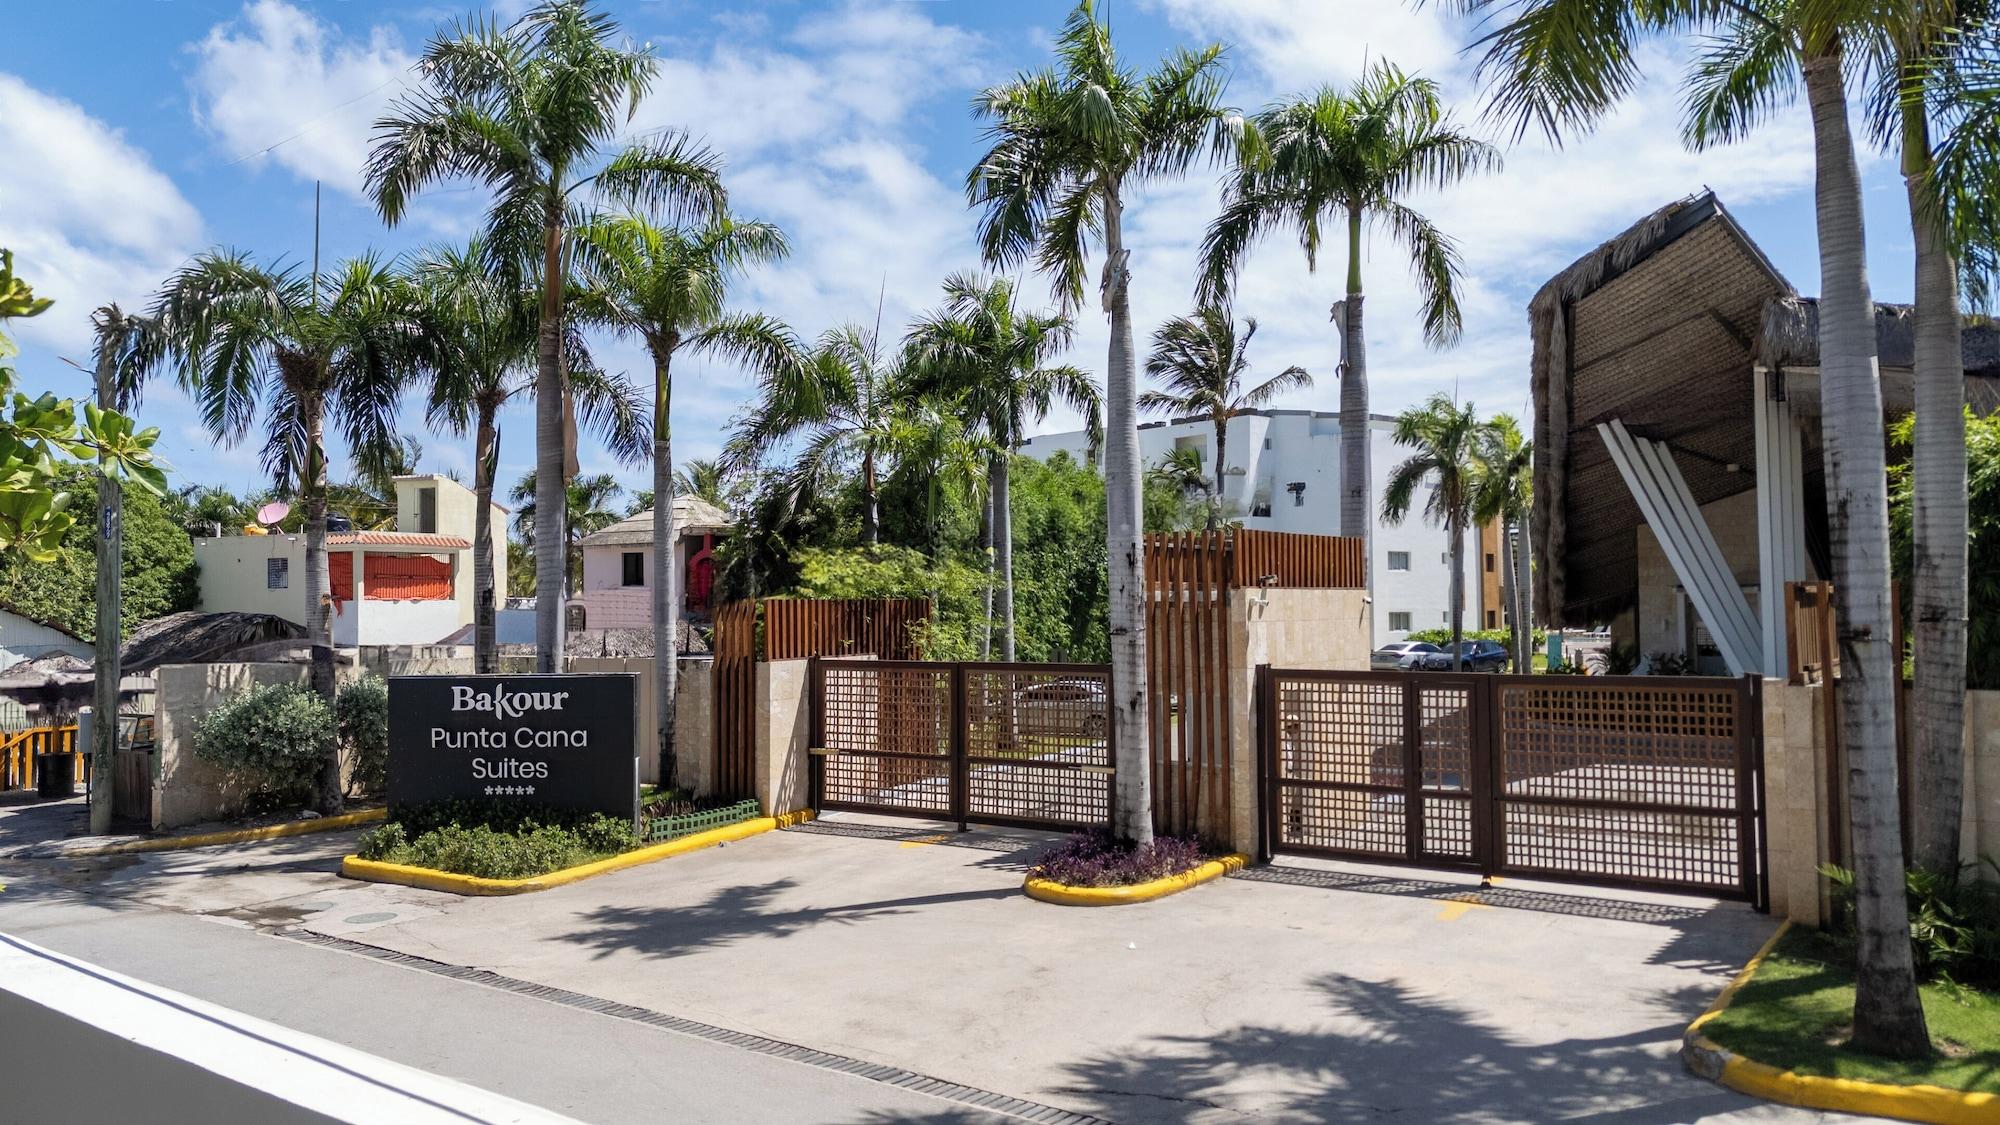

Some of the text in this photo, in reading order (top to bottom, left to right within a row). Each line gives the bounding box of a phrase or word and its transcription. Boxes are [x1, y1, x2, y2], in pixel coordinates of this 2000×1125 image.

[451, 683, 569, 721] Bakour
[431, 727, 587, 749] Punta Cana
[472, 757, 549, 779] Suites
